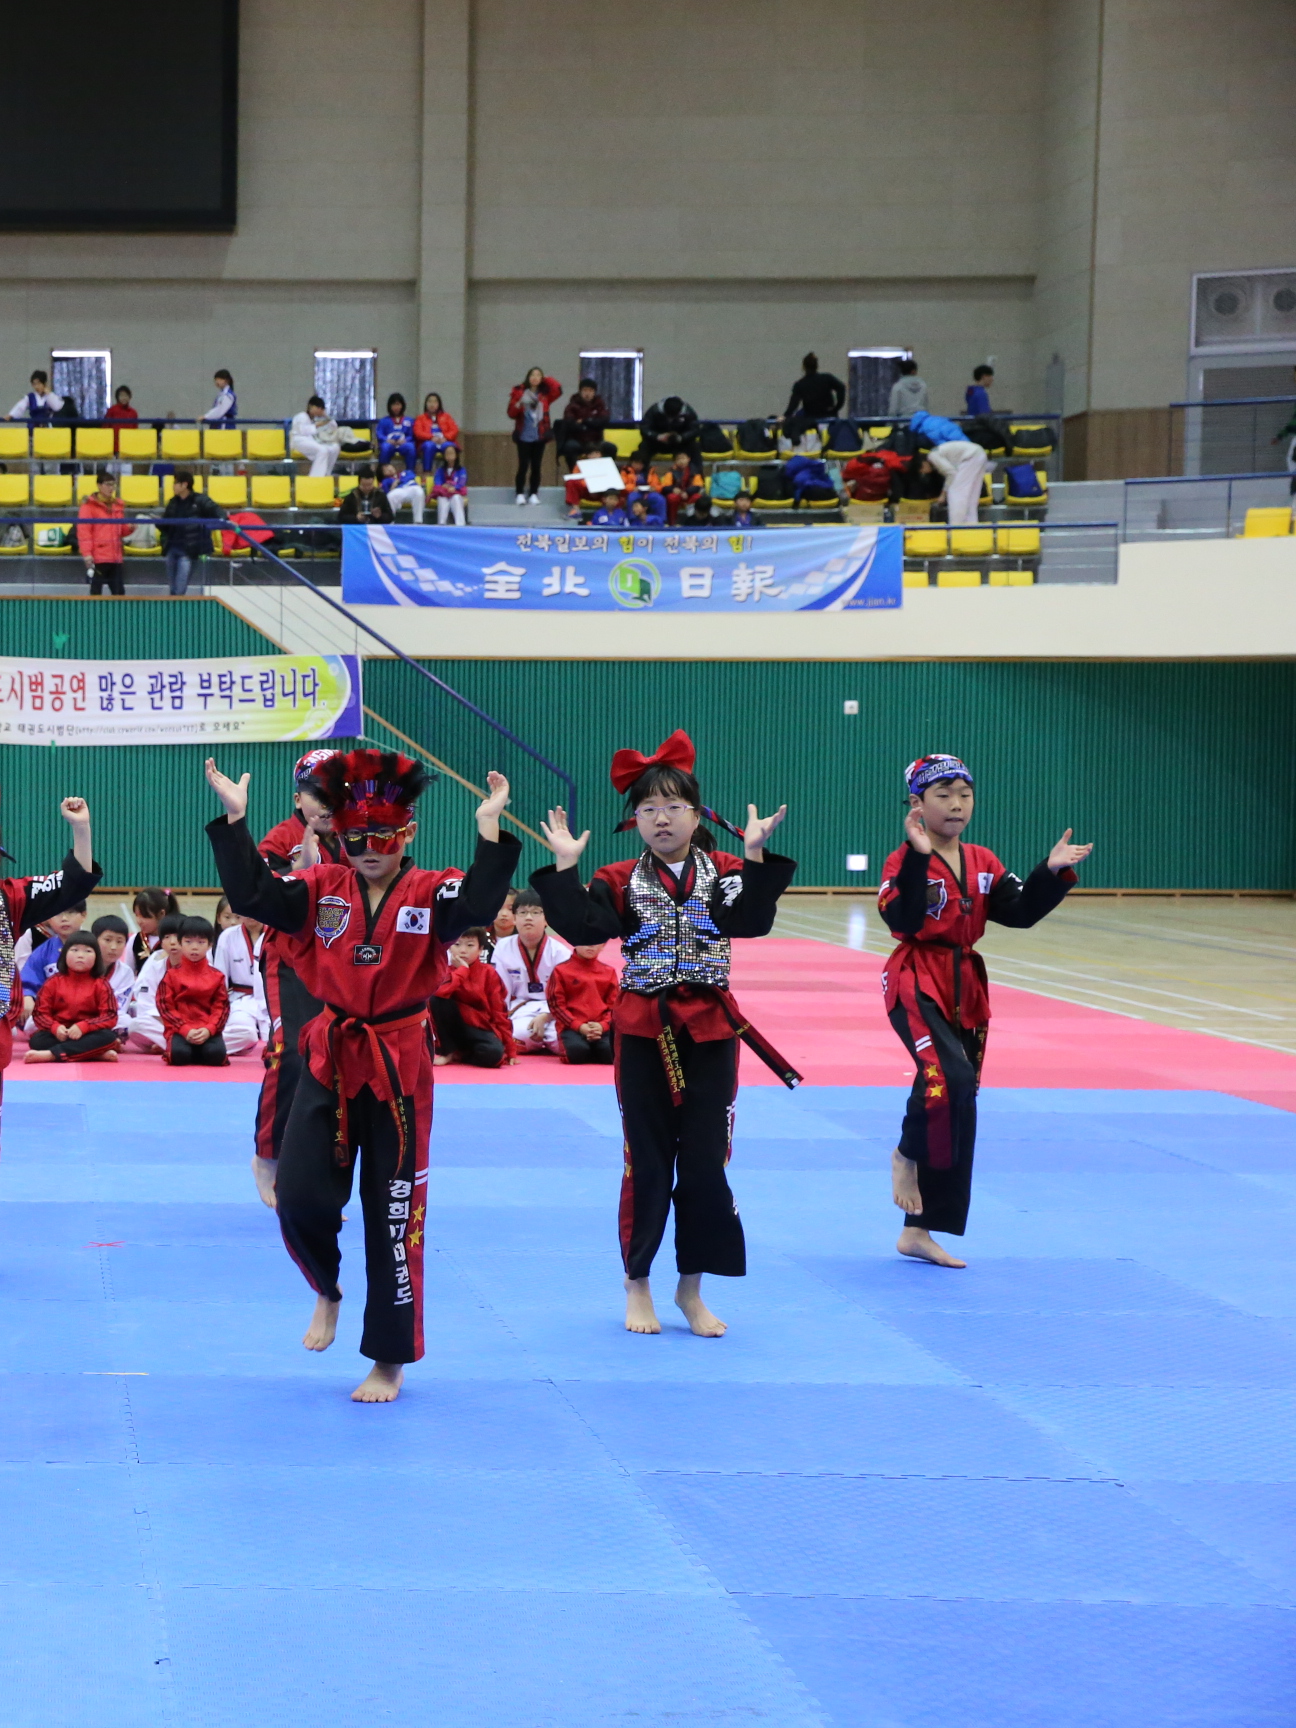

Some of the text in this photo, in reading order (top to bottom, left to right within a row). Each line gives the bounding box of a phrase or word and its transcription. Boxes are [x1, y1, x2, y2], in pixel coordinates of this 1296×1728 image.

[98, 671, 136, 712] 많은
[147, 671, 187, 711] 관람
[197, 667, 328, 711] 부탁드립니다.
